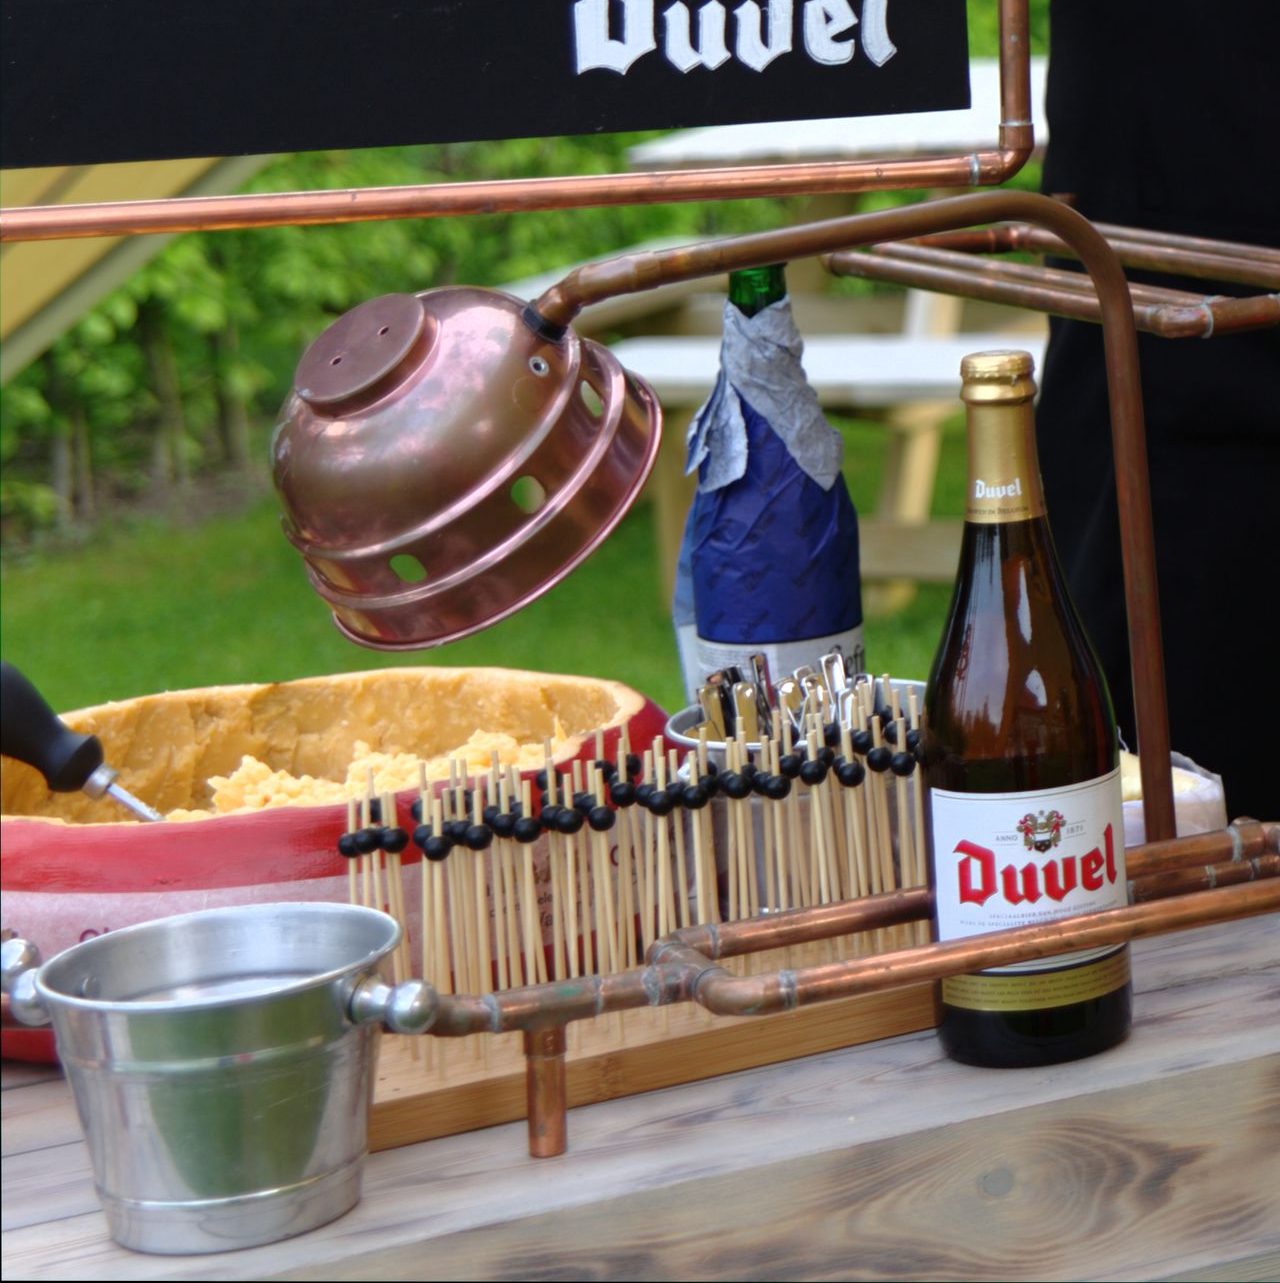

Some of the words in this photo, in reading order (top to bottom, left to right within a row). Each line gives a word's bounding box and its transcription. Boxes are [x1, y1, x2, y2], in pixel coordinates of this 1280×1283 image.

[976, 477, 1023, 498] Duvel
[995, 833, 1018, 843] ANNO
[953, 822, 1117, 907] Duvel
